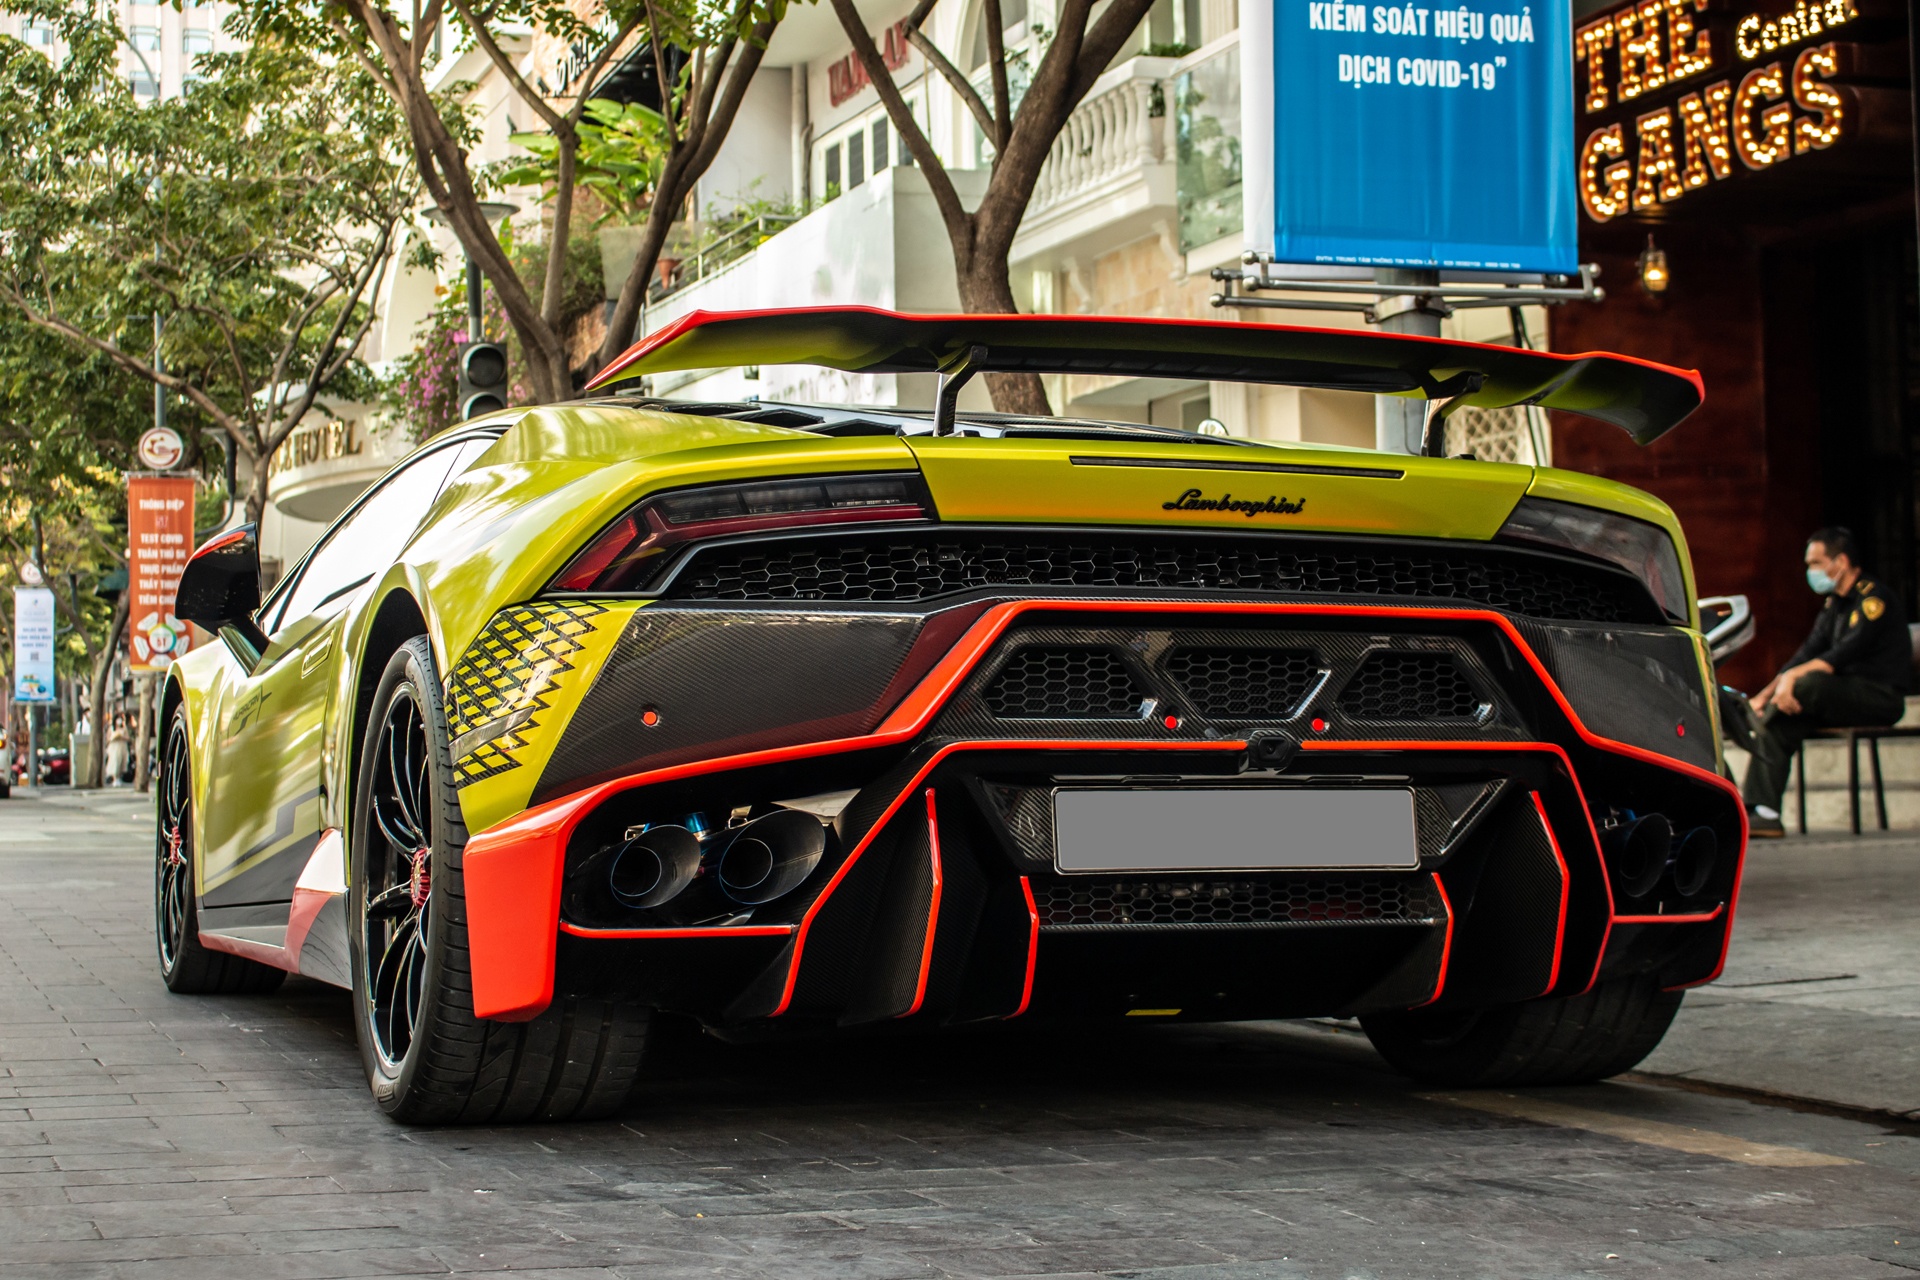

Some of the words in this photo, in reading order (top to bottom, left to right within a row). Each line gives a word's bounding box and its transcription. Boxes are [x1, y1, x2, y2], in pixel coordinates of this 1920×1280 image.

[1373, 2, 1429, 36] SOÁT
[1434, 6, 1484, 45] HIỆU
[1490, 7, 1535, 44] QUẢ
[1339, 54, 1391, 89] DỊCH
[1576, 0, 1712, 114] THE
[1579, 41, 1843, 223] GANGS
[294, 420, 363, 468] HOTEL
[1162, 488, 1306, 517] Lamborghini
